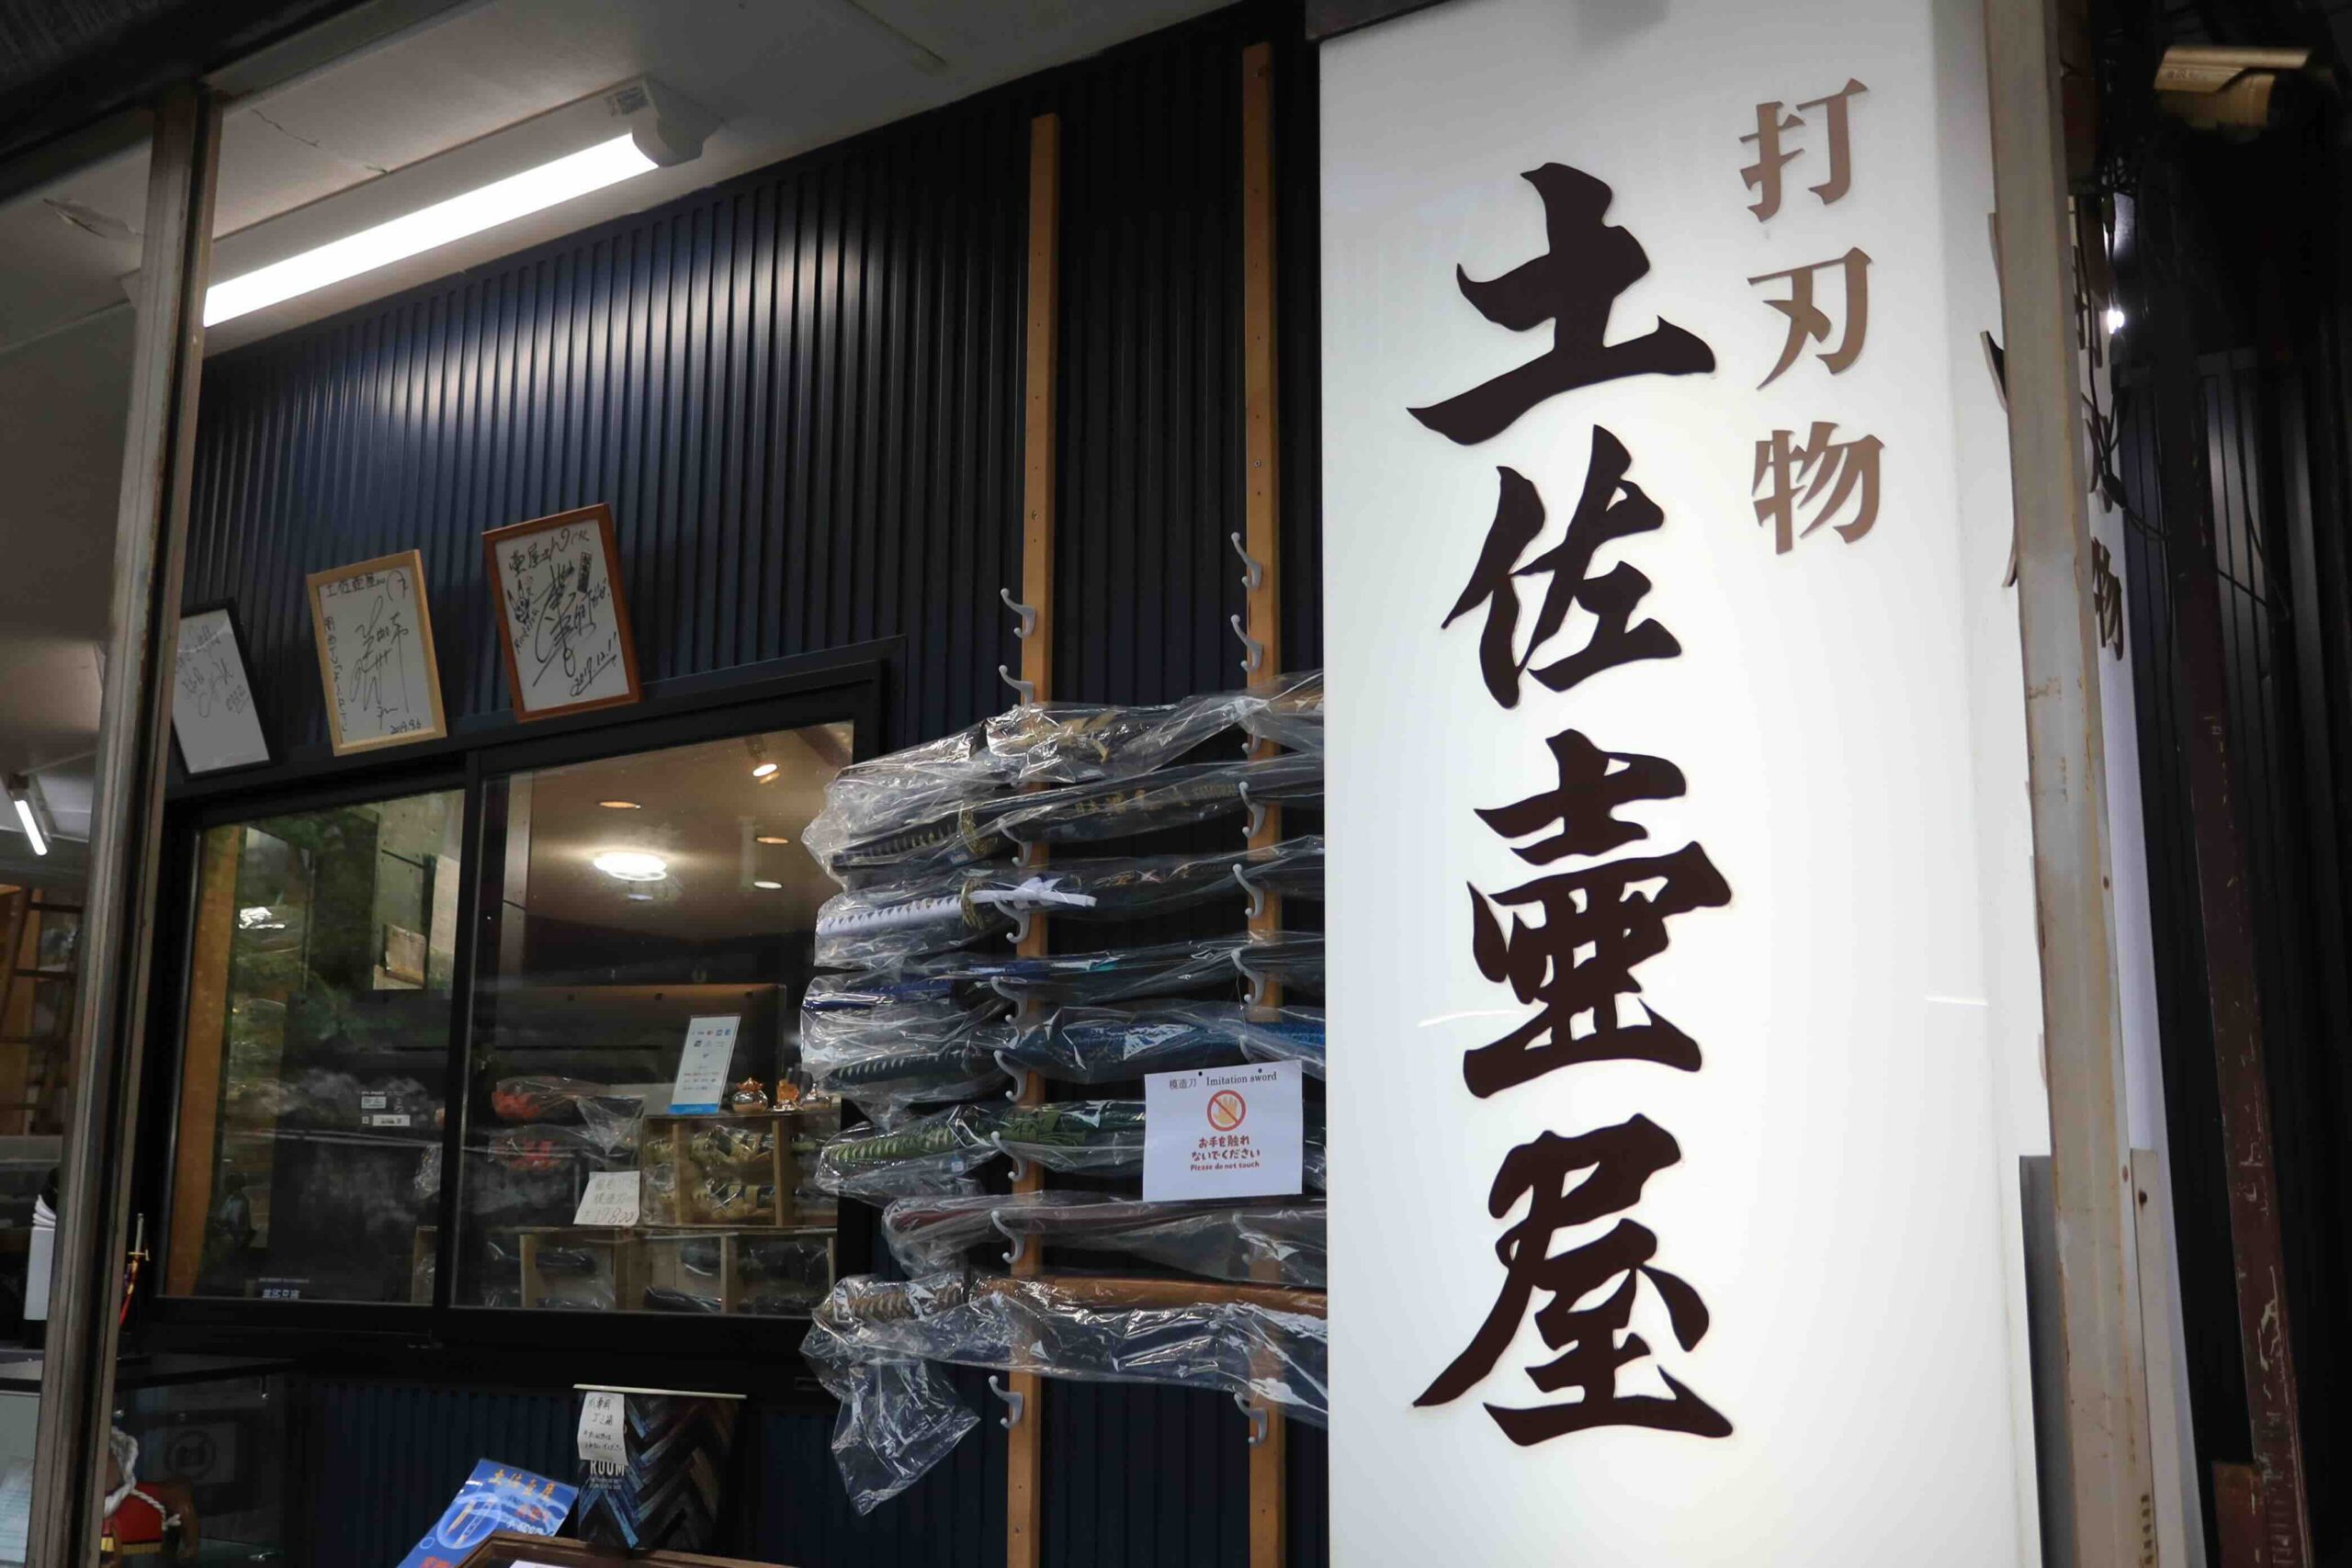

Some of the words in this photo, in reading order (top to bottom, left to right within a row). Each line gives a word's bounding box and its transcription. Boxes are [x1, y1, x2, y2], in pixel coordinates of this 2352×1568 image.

[1738, 77, 1885, 556] 打刃物
[1169, 1077, 1197, 1089] 模造刀
[1206, 1075, 1248, 1087] Imitation
[1250, 1070, 1278, 1083] sword
[1198, 1134, 1250, 1149] お手を触れ
[1191, 1148, 1261, 1162] ないでください
[1190, 1163, 1214, 1172] Please
[1214, 1162, 1224, 1170] do
[1238, 1160, 1261, 1169] touch
